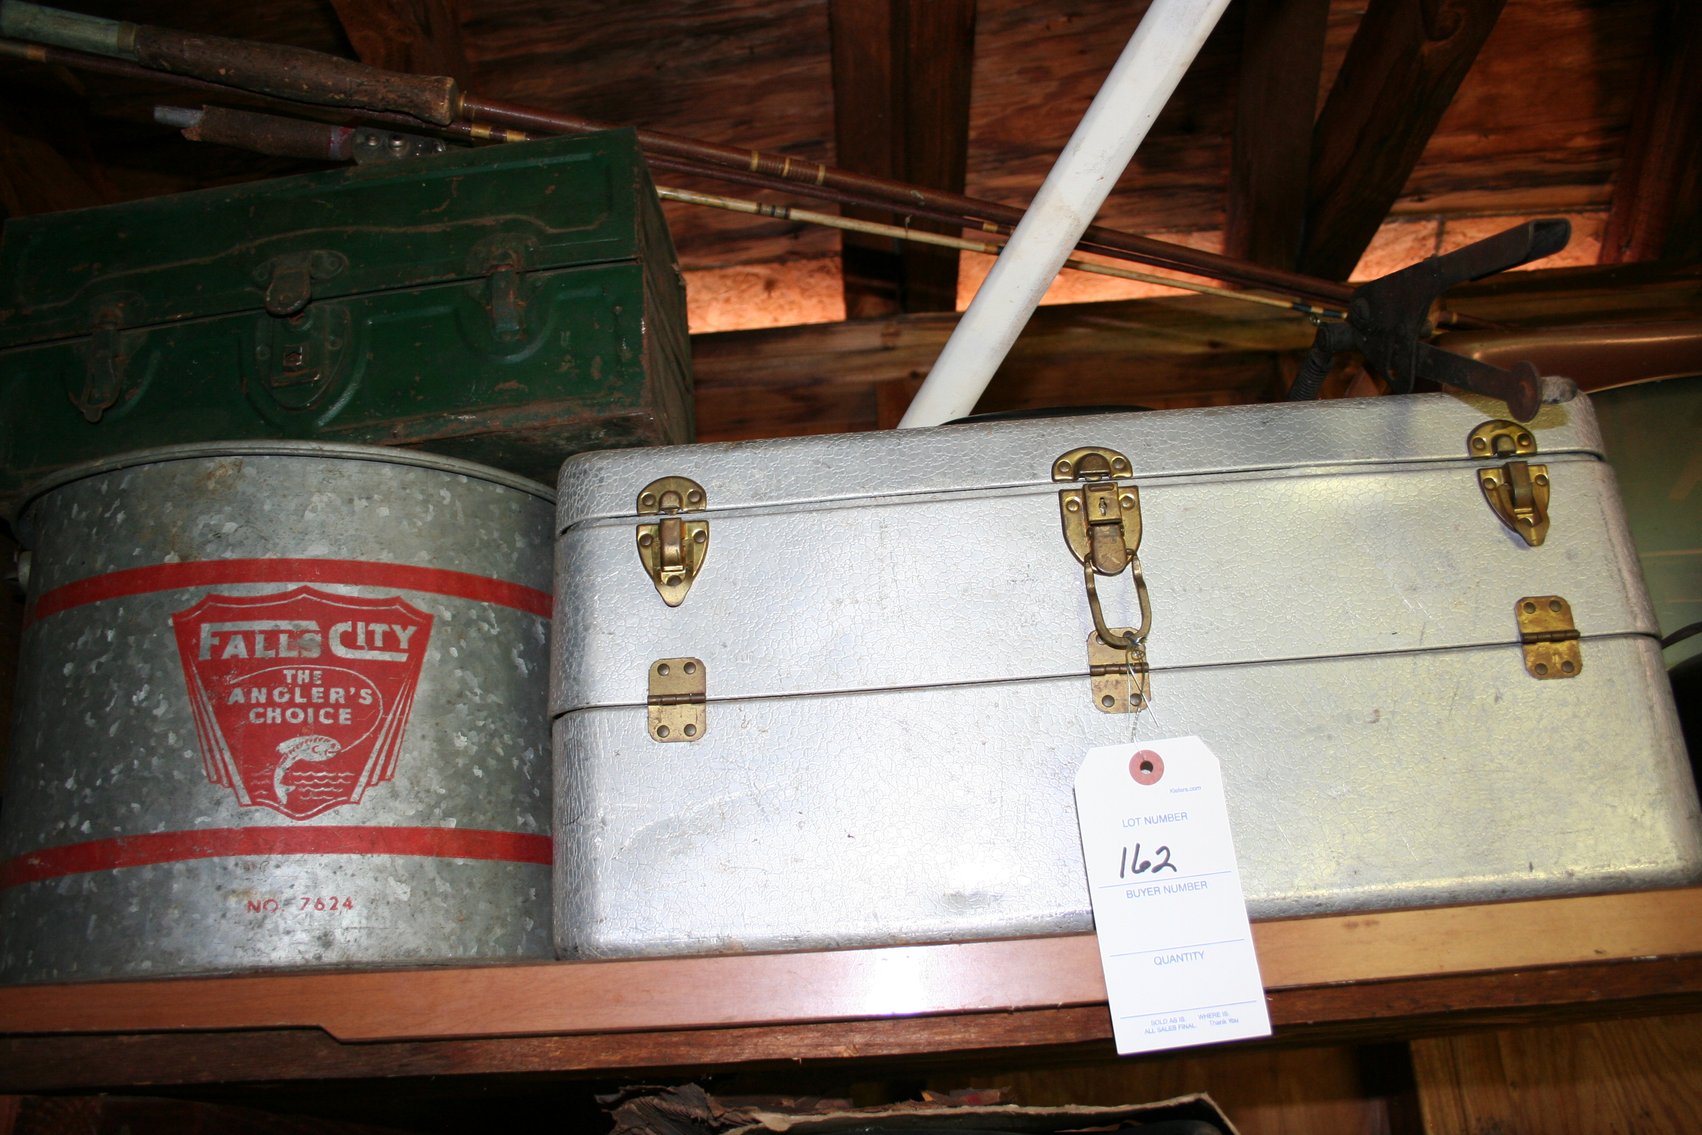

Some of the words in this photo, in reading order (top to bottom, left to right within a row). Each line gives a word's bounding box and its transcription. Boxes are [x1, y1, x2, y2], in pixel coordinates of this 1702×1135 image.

[198, 620, 322, 661] FALLS
[328, 621, 418, 662] CITY
[283, 669, 323, 685] THE
[227, 687, 373, 705] ANGLER'S
[249, 707, 352, 725] CHOICE
[1122, 817, 1142, 828] LOT
[1144, 812, 1188, 825] NUMBER
[1120, 843, 1177, 879] 162
[1126, 886, 1161, 899] BUYER
[1164, 880, 1208, 894] NUMBER
[300, 896, 353, 911] 7624
[1153, 950, 1205, 966] QUANTITY
[1151, 1018, 1168, 1026] SOLD
[1198, 1012, 1221, 1020] WHERE
[1157, 1024, 1178, 1033] SALES
